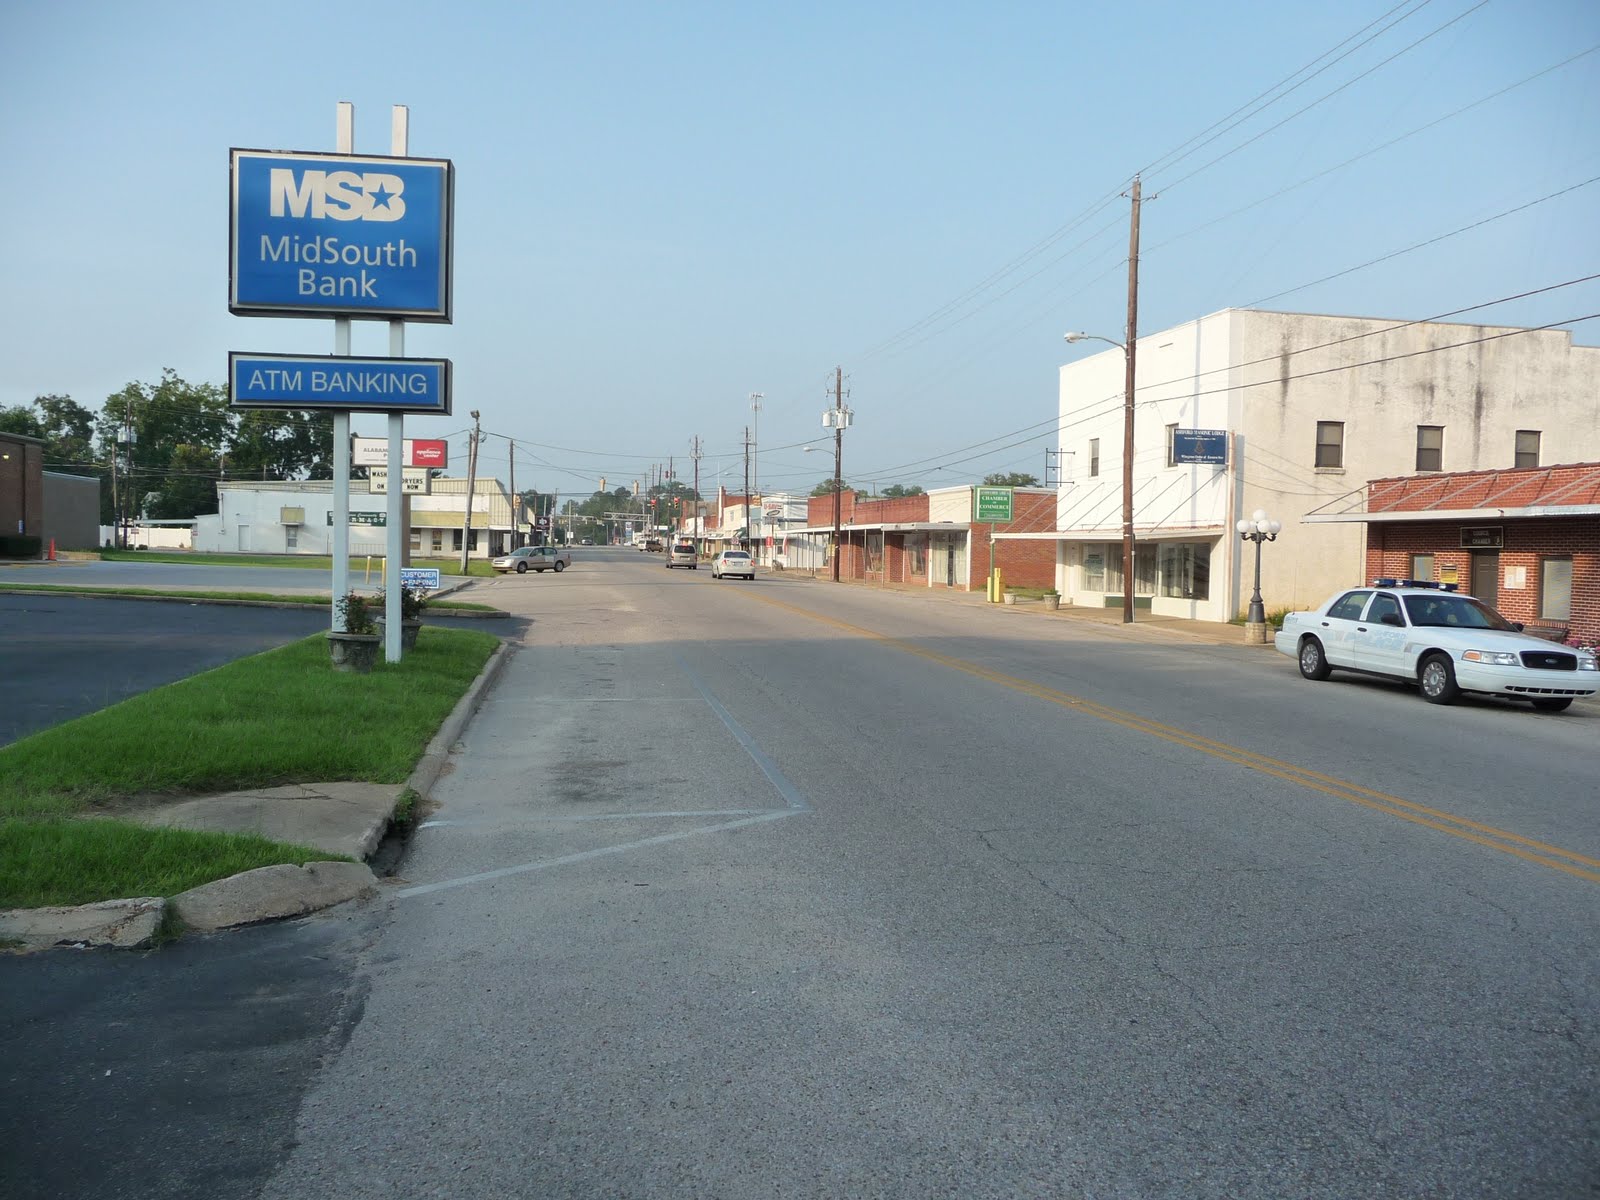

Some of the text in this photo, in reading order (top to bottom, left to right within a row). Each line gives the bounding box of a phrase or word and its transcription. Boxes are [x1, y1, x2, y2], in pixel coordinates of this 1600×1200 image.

[269, 168, 406, 222] MSB
[260, 235, 417, 267] MidSouth
[298, 269, 378, 298] Bank
[248, 370, 427, 394] ATM BANKING
